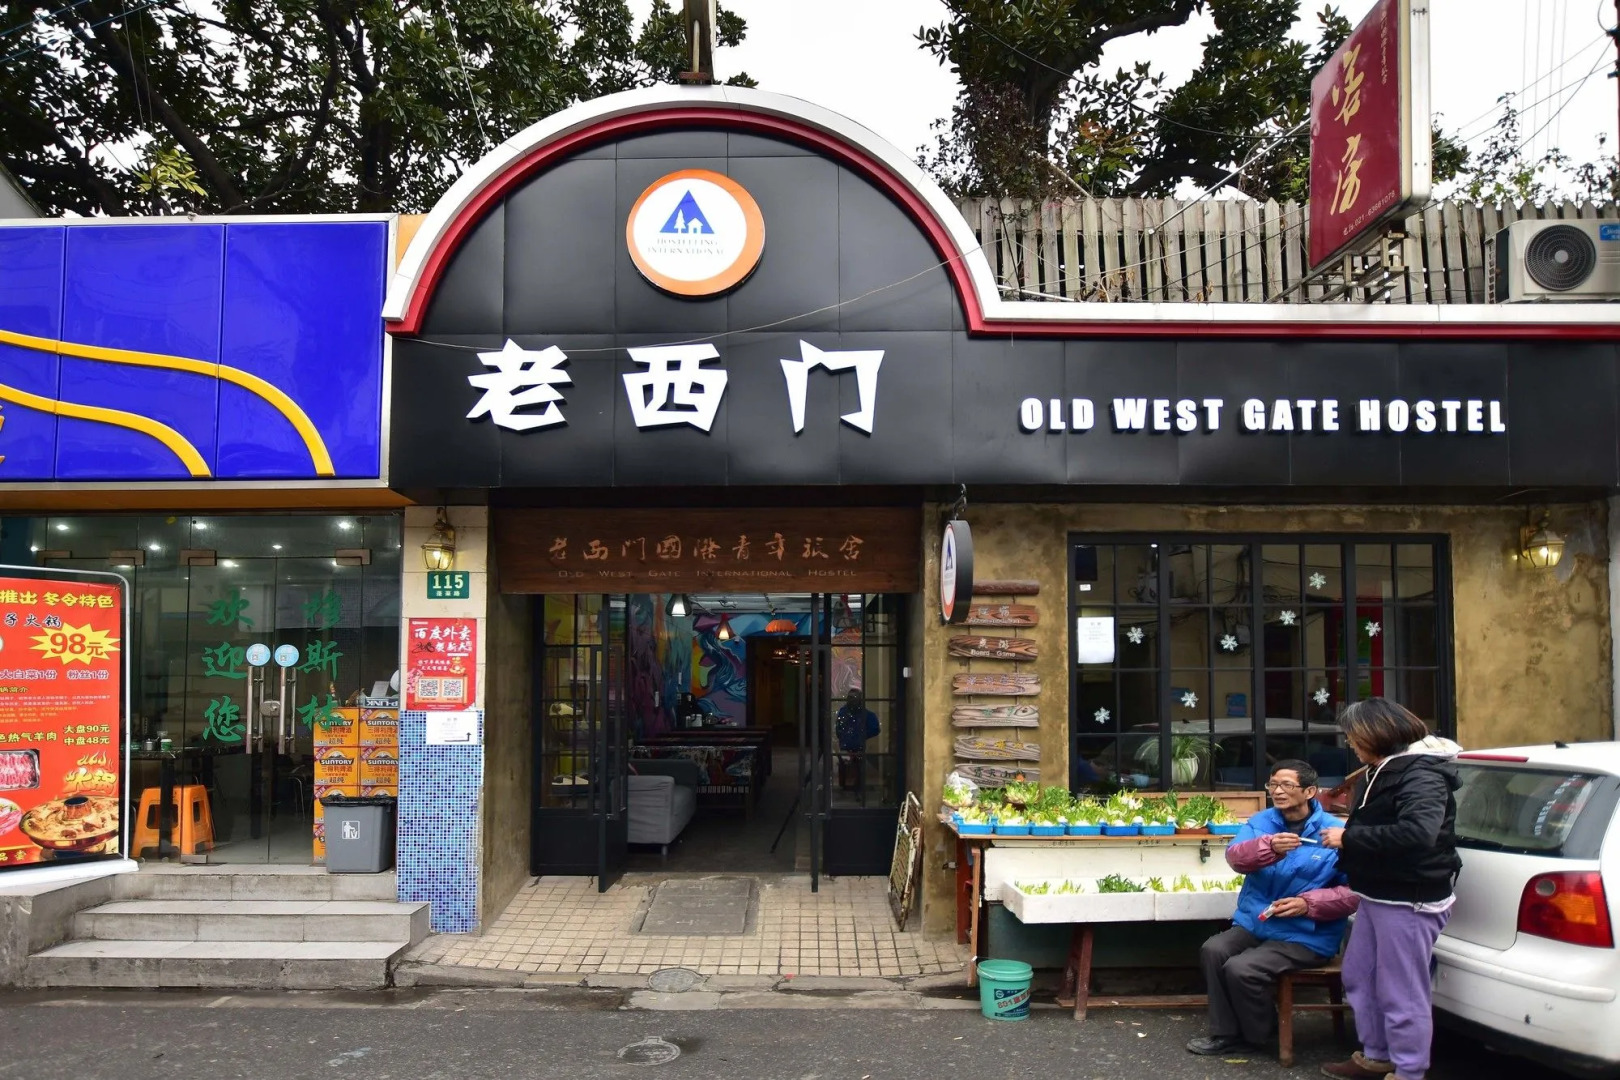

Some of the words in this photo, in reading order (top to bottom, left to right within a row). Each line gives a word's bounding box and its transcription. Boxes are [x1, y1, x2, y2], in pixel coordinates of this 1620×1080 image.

[1331, 43, 1364, 216] 客房
[466, 338, 886, 436] 老西门
[1020, 398, 1095, 432] OLD
[1113, 398, 1224, 433] WEST
[1241, 397, 1341, 432] GATE
[1356, 399, 1507, 433] HOSTEL
[432, 574, 464, 589] 115
[43, 591, 114, 608] 冬令特色
[415, 625, 471, 641] 百度外卖
[50, 632, 104, 656] 98元
[297, 590, 343, 733] 穆斯林
[64, 724, 110, 735] 大盘90元
[64, 736, 110, 746] 中盘48元
